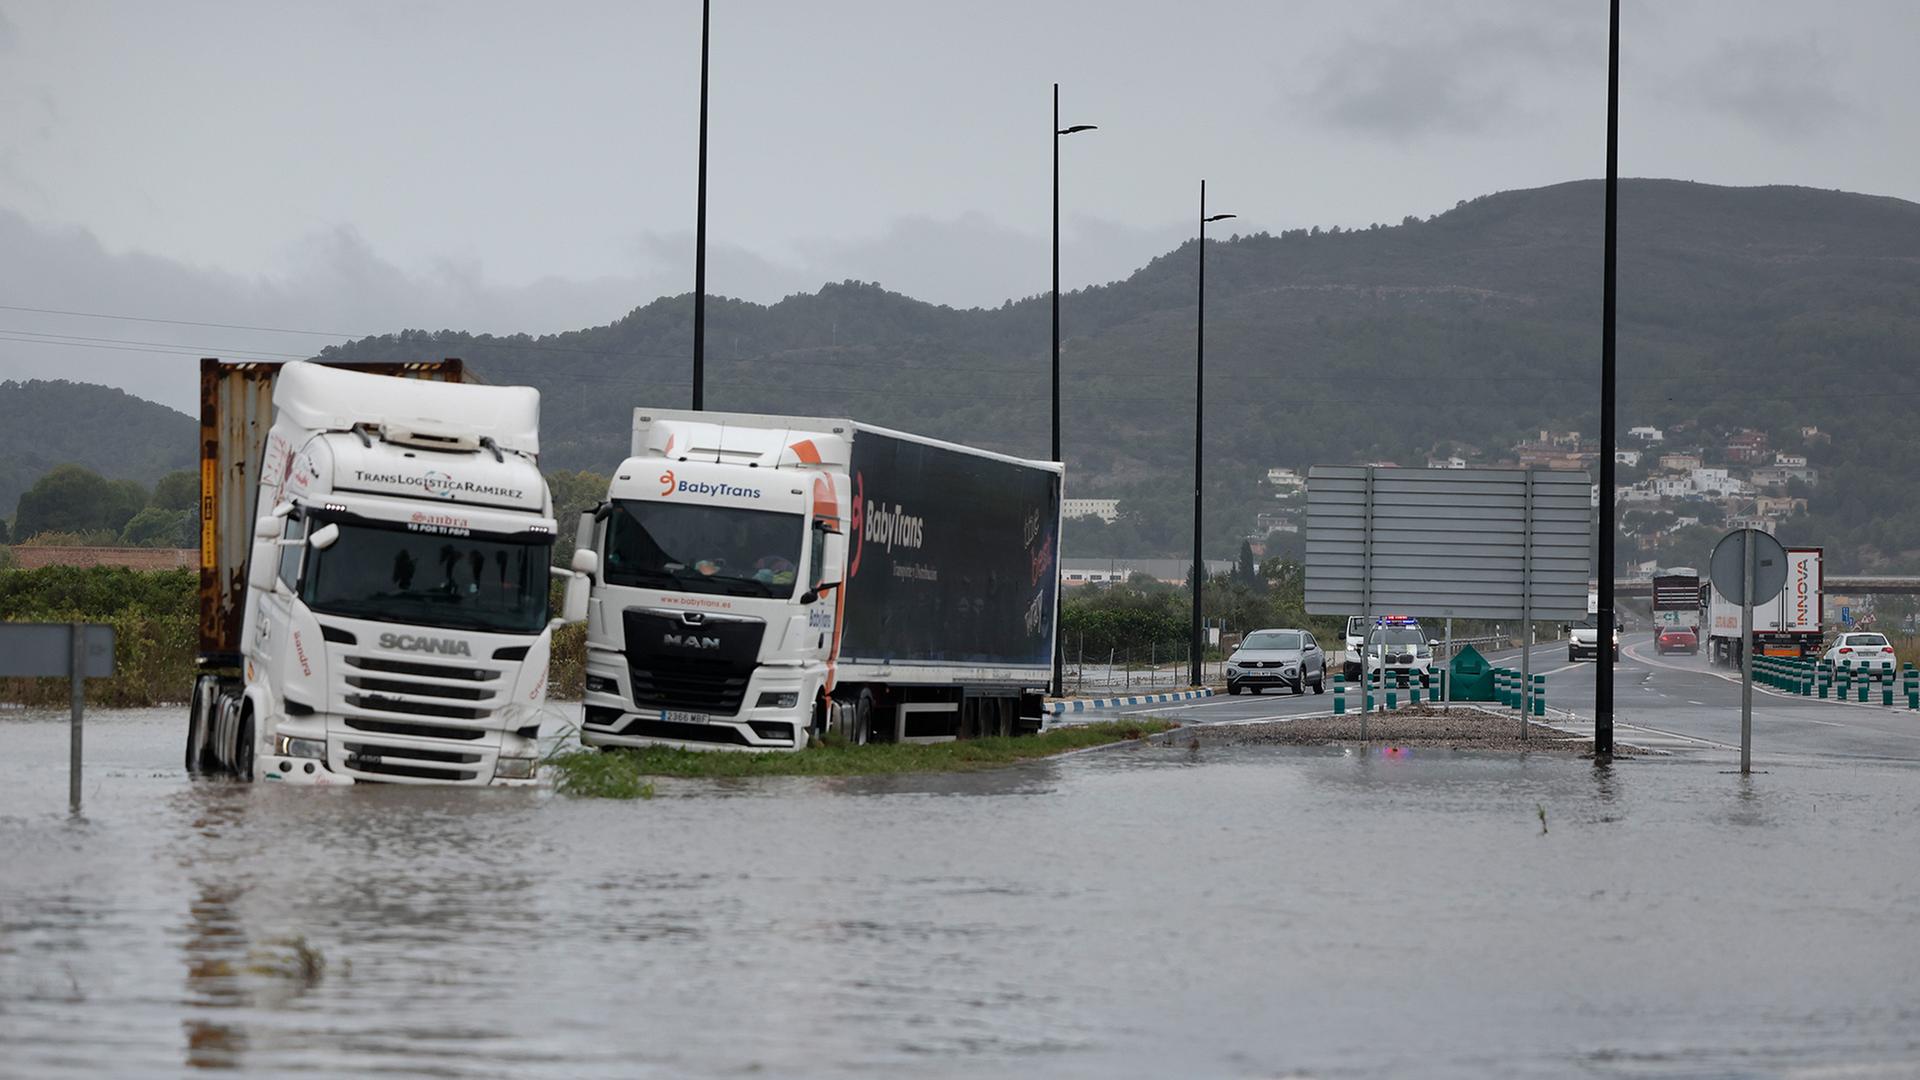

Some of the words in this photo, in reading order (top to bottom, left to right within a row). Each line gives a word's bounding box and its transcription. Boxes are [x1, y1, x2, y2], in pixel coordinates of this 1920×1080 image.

[678, 479, 761, 499] BabyTrans
[439, 526, 447, 534] TI
[865, 499, 924, 554] BabyTrans
[660, 596, 731, 609] www.babytrans.es
[1797, 559, 1808, 626] INNOVA
[378, 632, 473, 657] SCANIA
[663, 633, 721, 649] MAN
